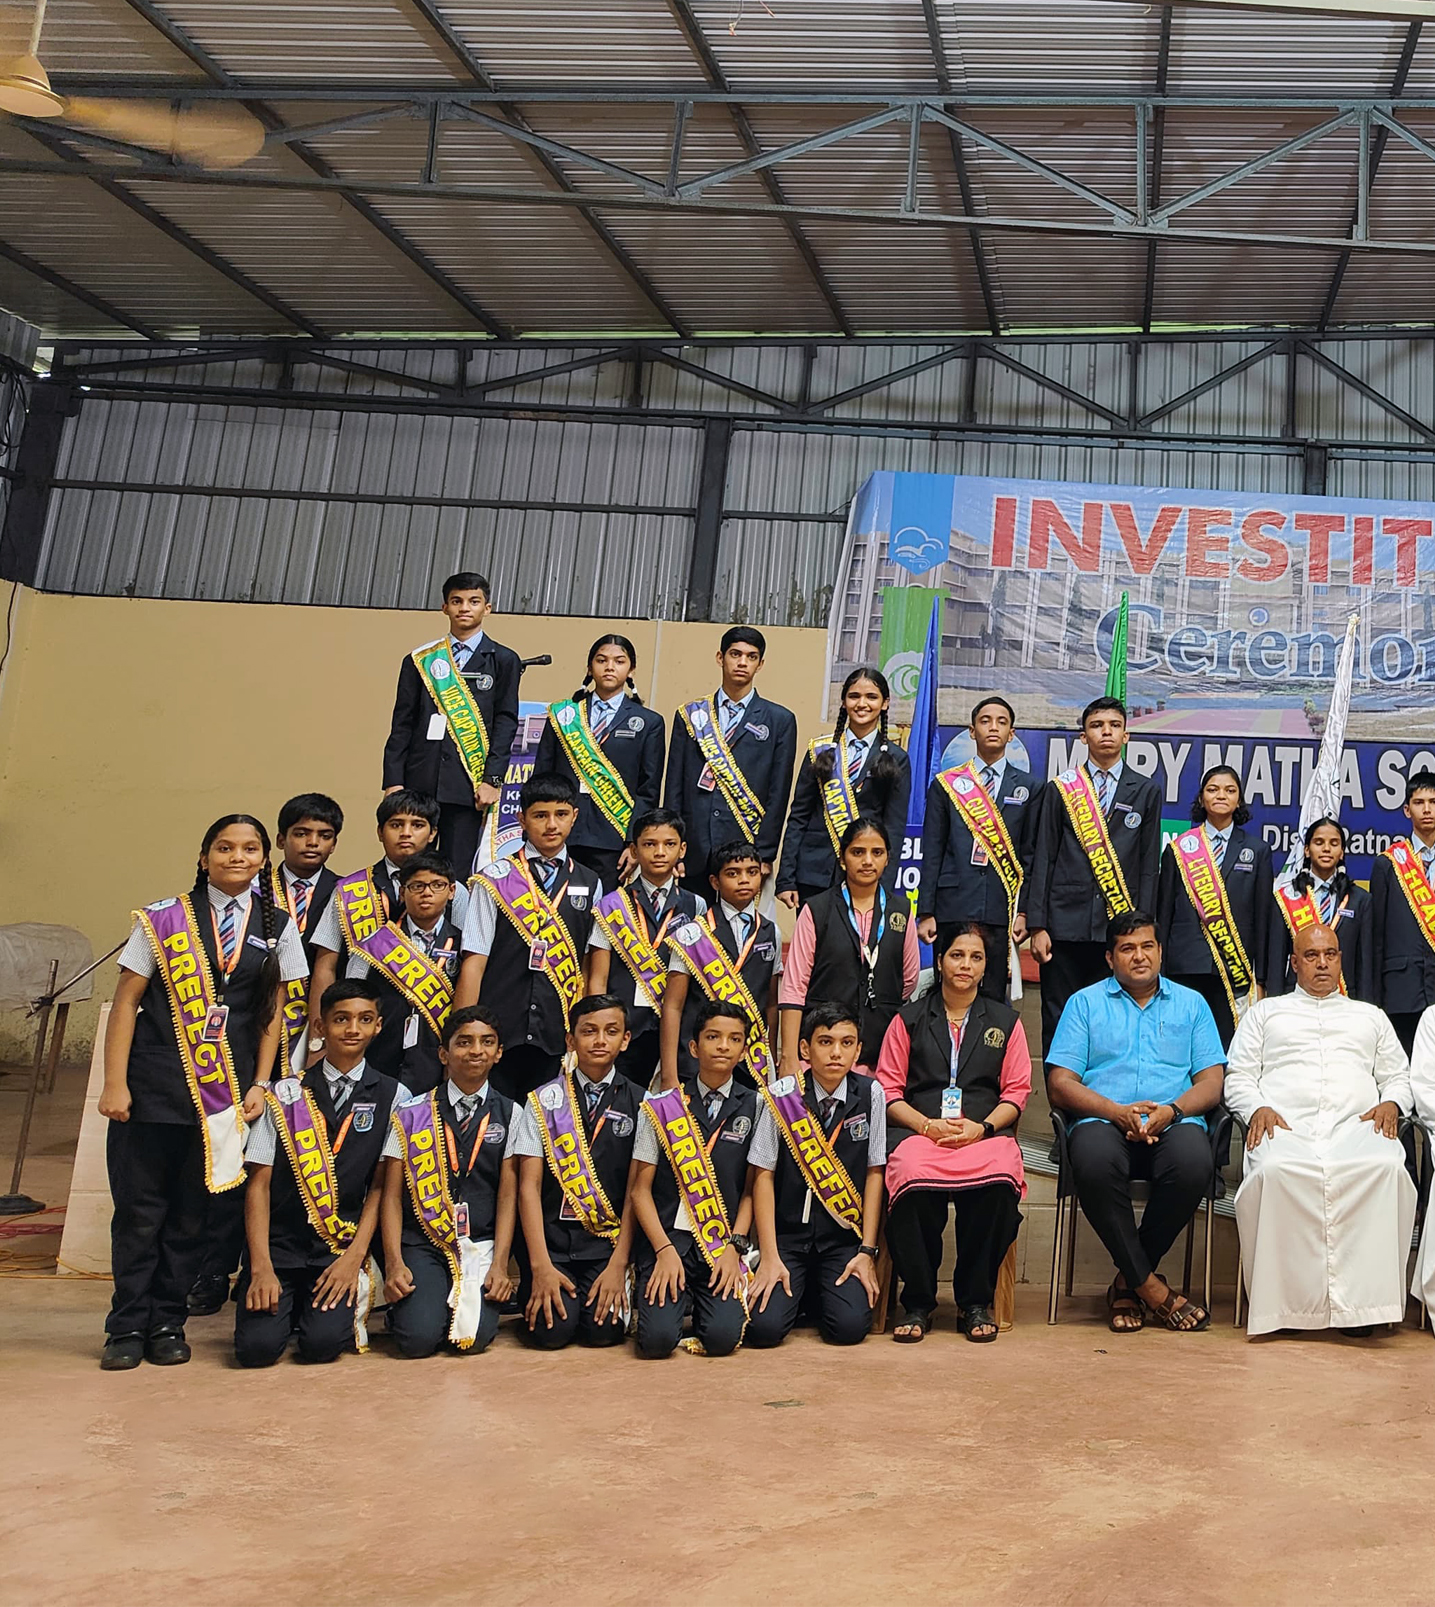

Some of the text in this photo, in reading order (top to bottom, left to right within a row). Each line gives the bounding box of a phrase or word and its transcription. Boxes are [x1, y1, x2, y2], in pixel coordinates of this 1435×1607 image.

[440, 685, 465, 711] VICE
[451, 709, 480, 753] CAPTAIN
[565, 730, 602, 778] CAPTAIN
[594, 775, 626, 814] GREEN
[1047, 737, 1193, 803] MRY
[1203, 743, 1364, 808] MATA
[1066, 788, 1102, 847] LITERARY
[1187, 857, 1222, 918] LITERARY
[382, 944, 453, 1029] PREF
[605, 908, 667, 996] PREFE
[163, 931, 225, 1084] PREFECT
[295, 1127, 356, 1240] PREFEC
[790, 1117, 862, 1224] PREFEC
